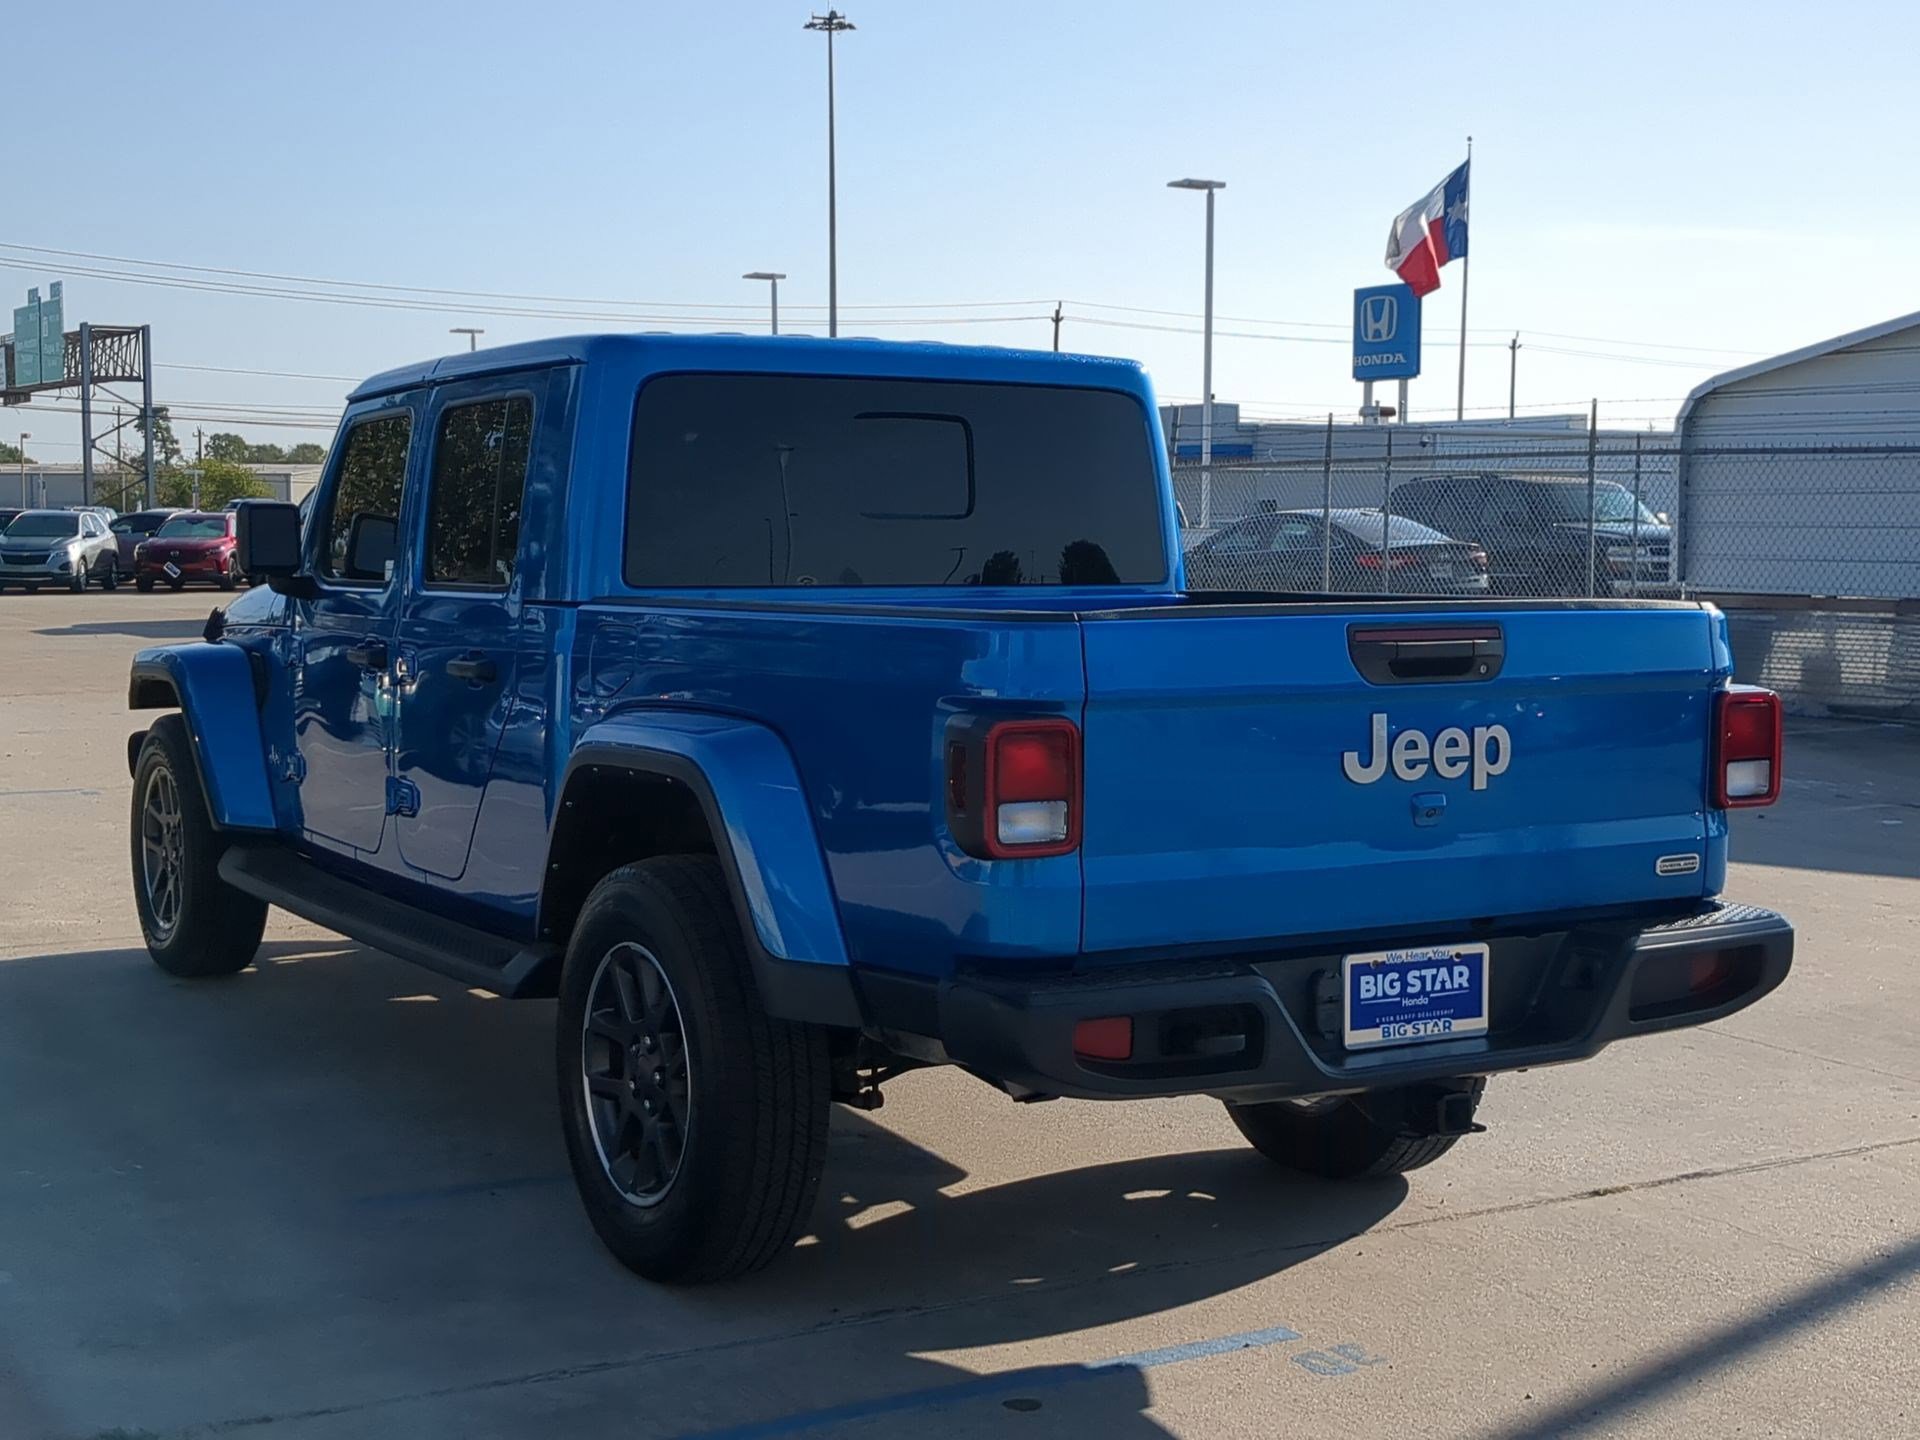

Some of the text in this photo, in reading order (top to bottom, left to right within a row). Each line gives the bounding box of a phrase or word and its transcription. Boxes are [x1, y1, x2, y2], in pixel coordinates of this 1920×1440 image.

[1354, 352, 1407, 367] HONDA
[1343, 713, 1512, 790] Jeep
[1385, 948, 1451, 964] We Hear You
[1360, 965, 1470, 999] BIG STAR
[1402, 995, 1429, 1007] Honda
[1382, 1019, 1453, 1039] BIG STAR
